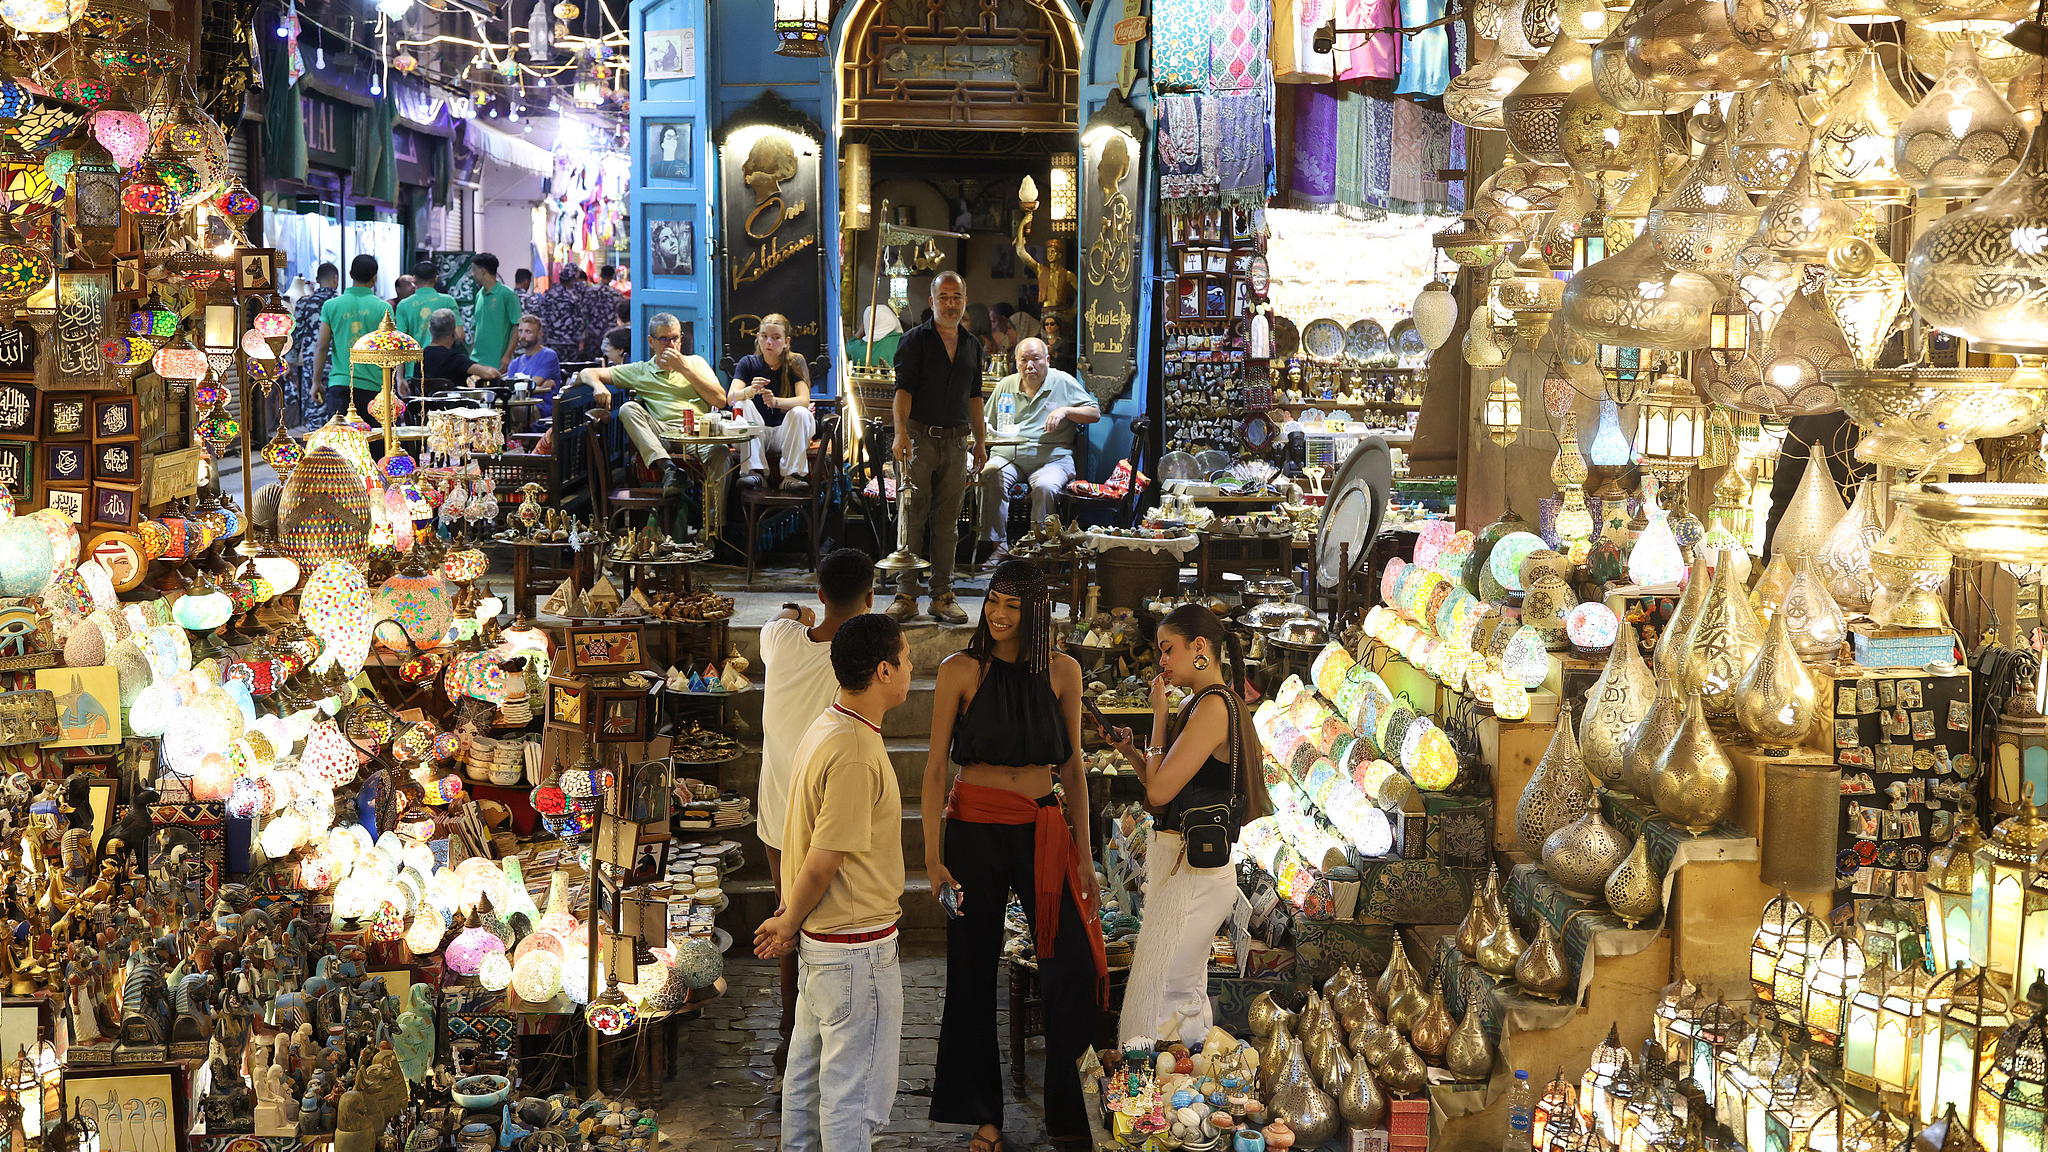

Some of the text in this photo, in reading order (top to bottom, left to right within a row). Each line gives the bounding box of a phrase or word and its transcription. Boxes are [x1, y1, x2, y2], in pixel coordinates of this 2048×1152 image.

[1096, 310, 1120, 328] كافيه
[1092, 337, 1123, 356] مطعم
[848, 928, 890, 944] HUGO
